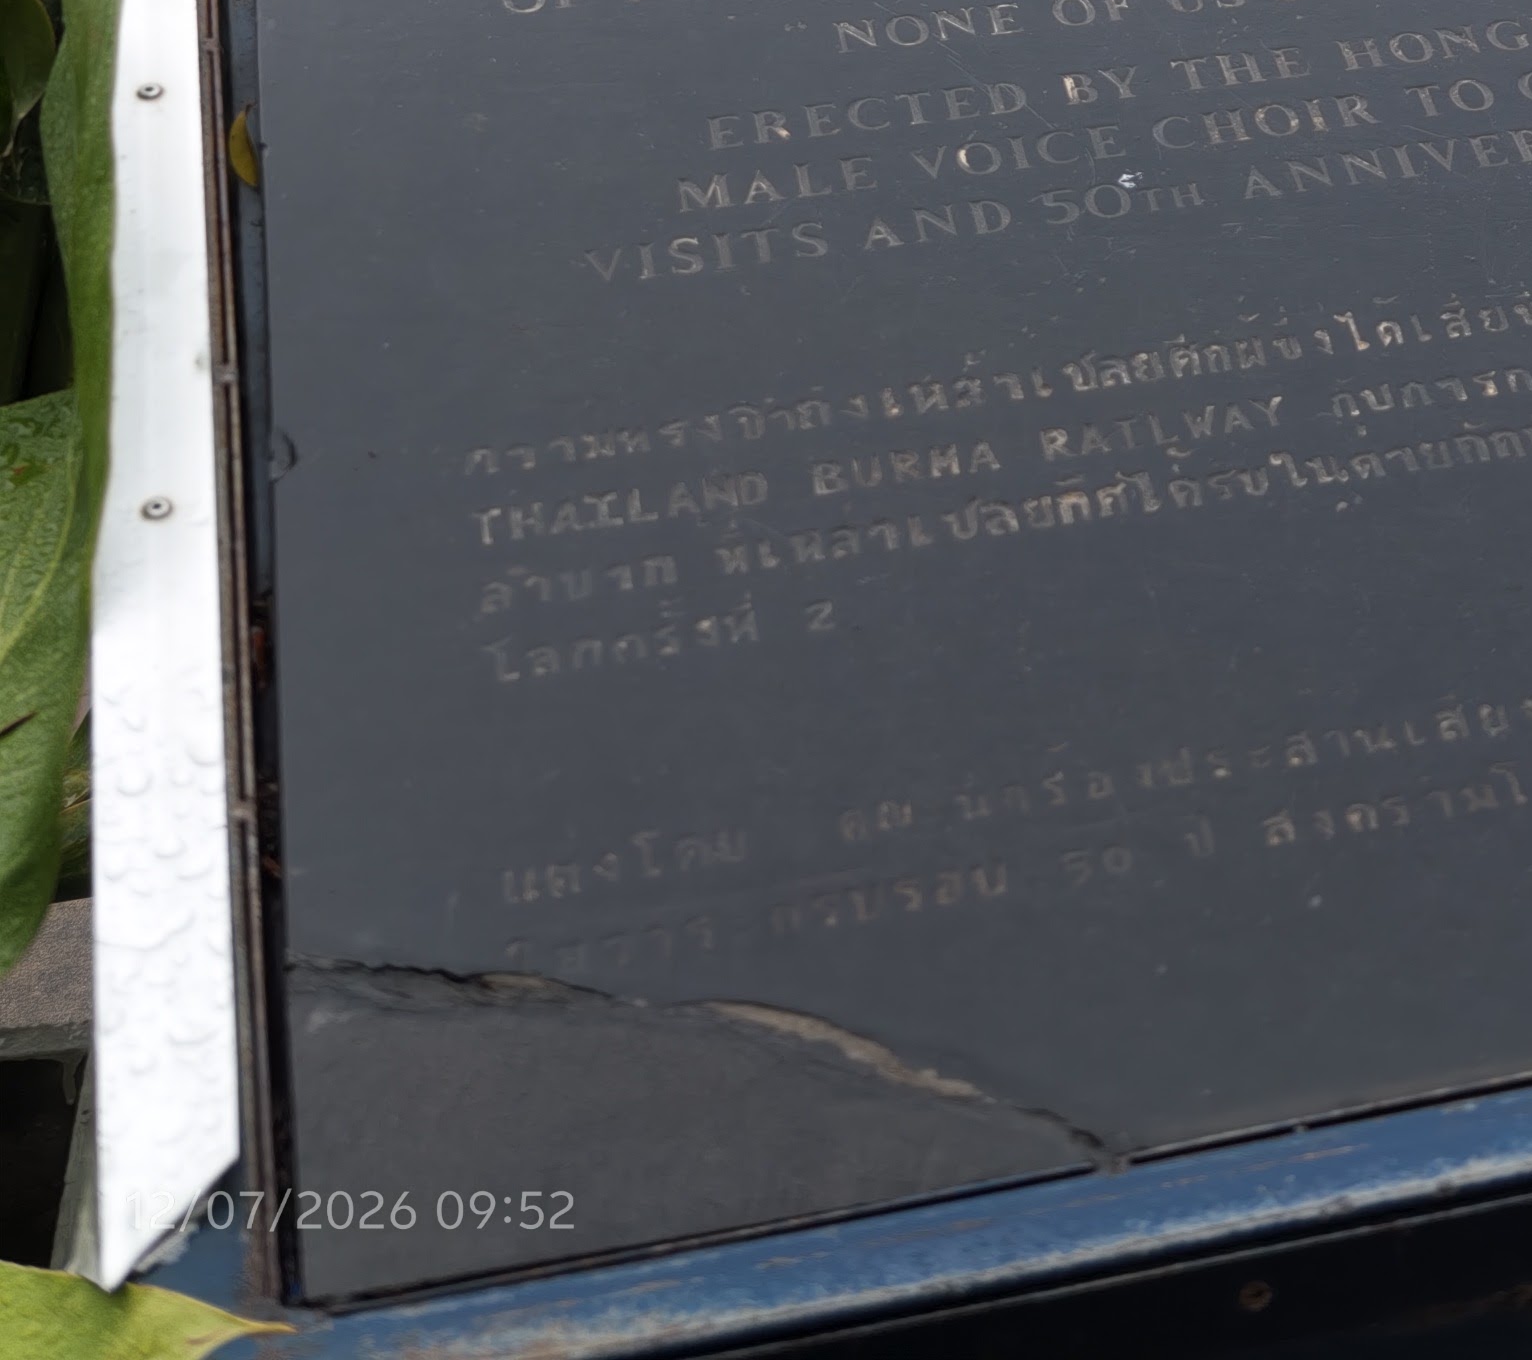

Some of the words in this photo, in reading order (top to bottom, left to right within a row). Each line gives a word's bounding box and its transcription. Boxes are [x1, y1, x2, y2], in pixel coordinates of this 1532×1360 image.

[677, 155, 878, 215] MALE
[911, 124, 1126, 183] VOICE
[1152, 93, 1381, 152] CHOIR
[1405, 78, 1495, 121] TO
[707, 82, 1028, 151] ERECTED
[1062, 64, 1138, 107] BY
[1169, 45, 1311, 92] THE
[584, 220, 829, 284] VISITS
[864, 199, 1012, 252] AND
[473, 471, 770, 548] THAILAND
[810, 440, 1002, 495] BURMA
[1040, 395, 1284, 460] RAILWAY
[803, 600, 838, 634] 2
